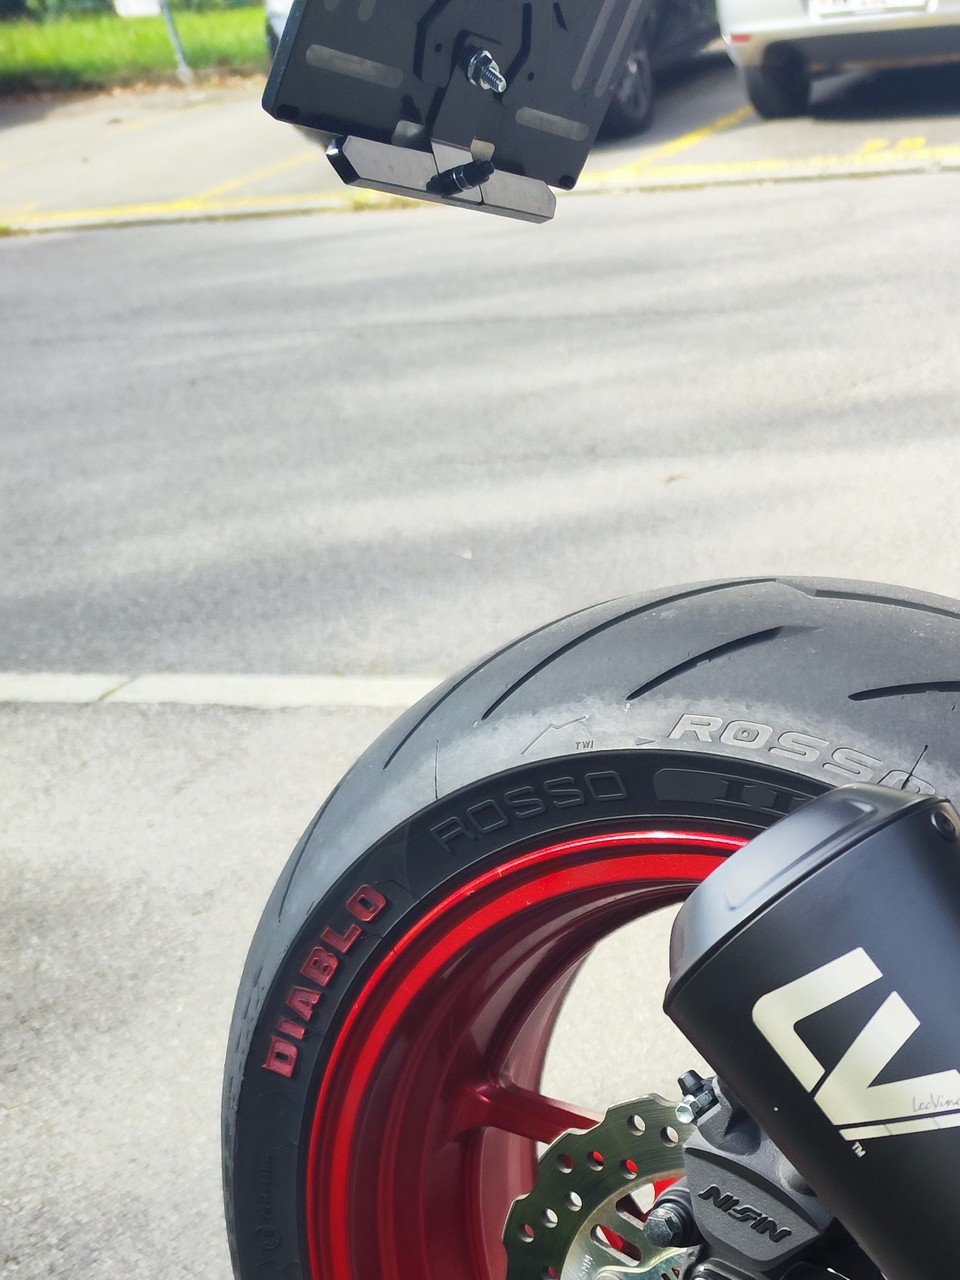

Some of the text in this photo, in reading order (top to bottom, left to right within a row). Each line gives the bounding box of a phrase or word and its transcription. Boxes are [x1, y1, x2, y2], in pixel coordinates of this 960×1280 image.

[575, 740, 594, 750] TWI
[667, 712, 936, 795] ROSSO
[263, 883, 388, 1078] DIABLO
[430, 769, 629, 856] ROSSO
